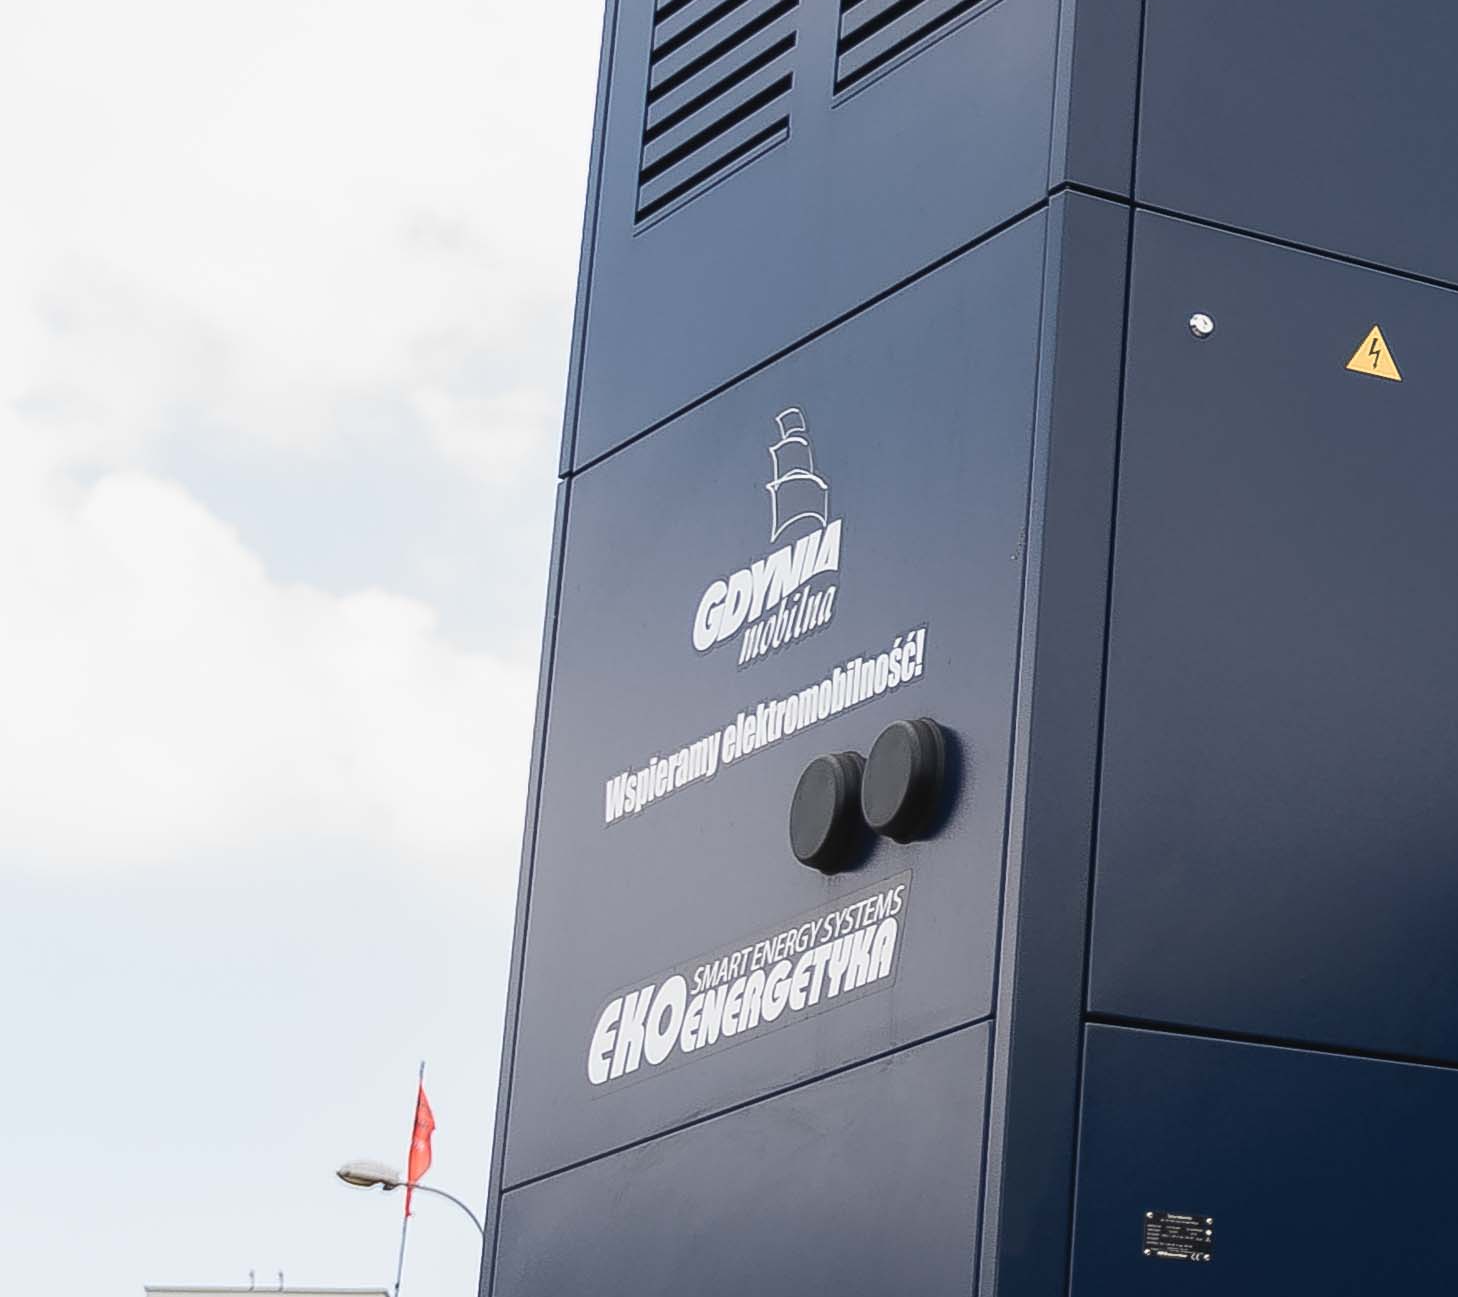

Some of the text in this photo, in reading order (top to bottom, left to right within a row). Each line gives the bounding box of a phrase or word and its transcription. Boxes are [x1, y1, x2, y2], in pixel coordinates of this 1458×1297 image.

[692, 519, 842, 651] GDYNIA
[738, 584, 837, 666] mobilna
[605, 628, 927, 823] Wspieramy elektromobilność!
[681, 917, 897, 1054] ENERGETYKA
[691, 885, 905, 994] SMART ENERGY SYSTEMS
[587, 972, 689, 1085] EKO
